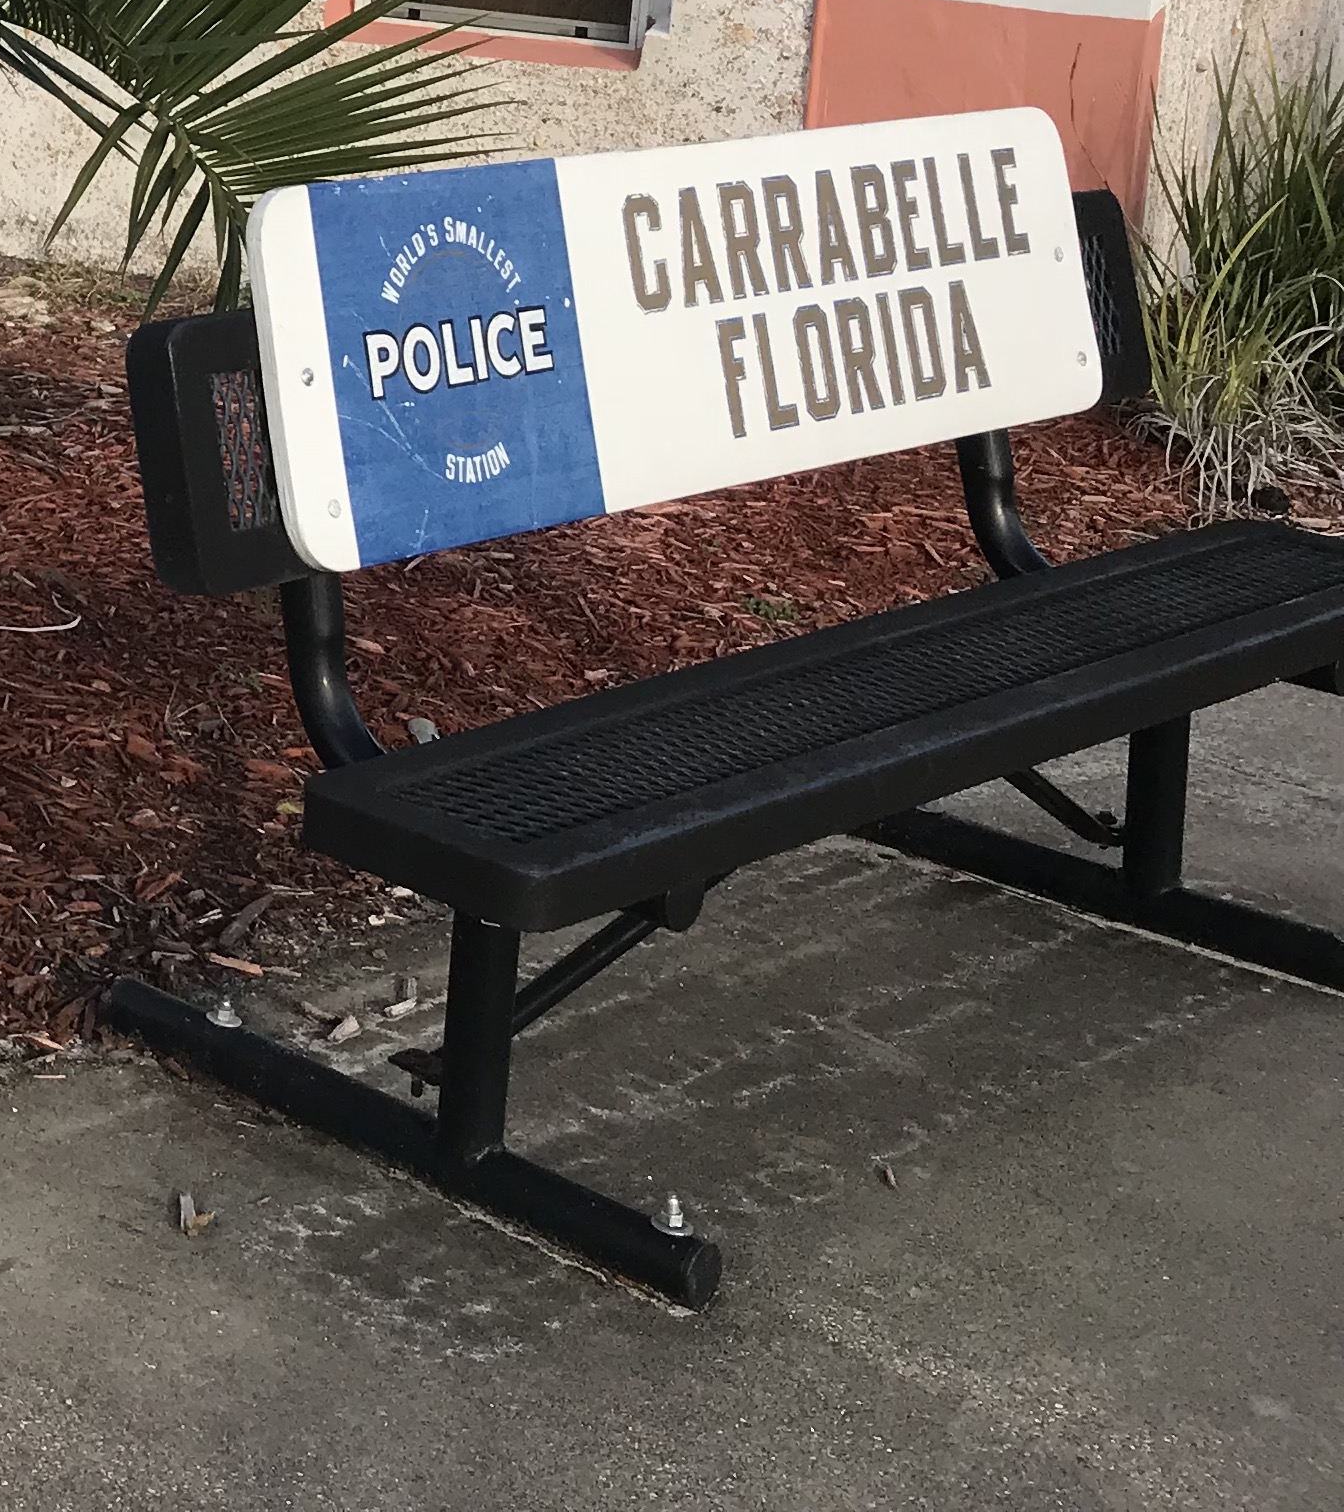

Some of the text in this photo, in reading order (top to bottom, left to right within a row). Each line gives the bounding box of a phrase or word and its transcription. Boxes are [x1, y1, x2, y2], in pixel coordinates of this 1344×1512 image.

[381, 216, 521, 305] WORLD'S SMALLEST
[622, 147, 1031, 315] CARRABELLE
[362, 305, 555, 401] POLICE
[715, 279, 992, 438] FLORIDA
[445, 442, 511, 484] STATION
